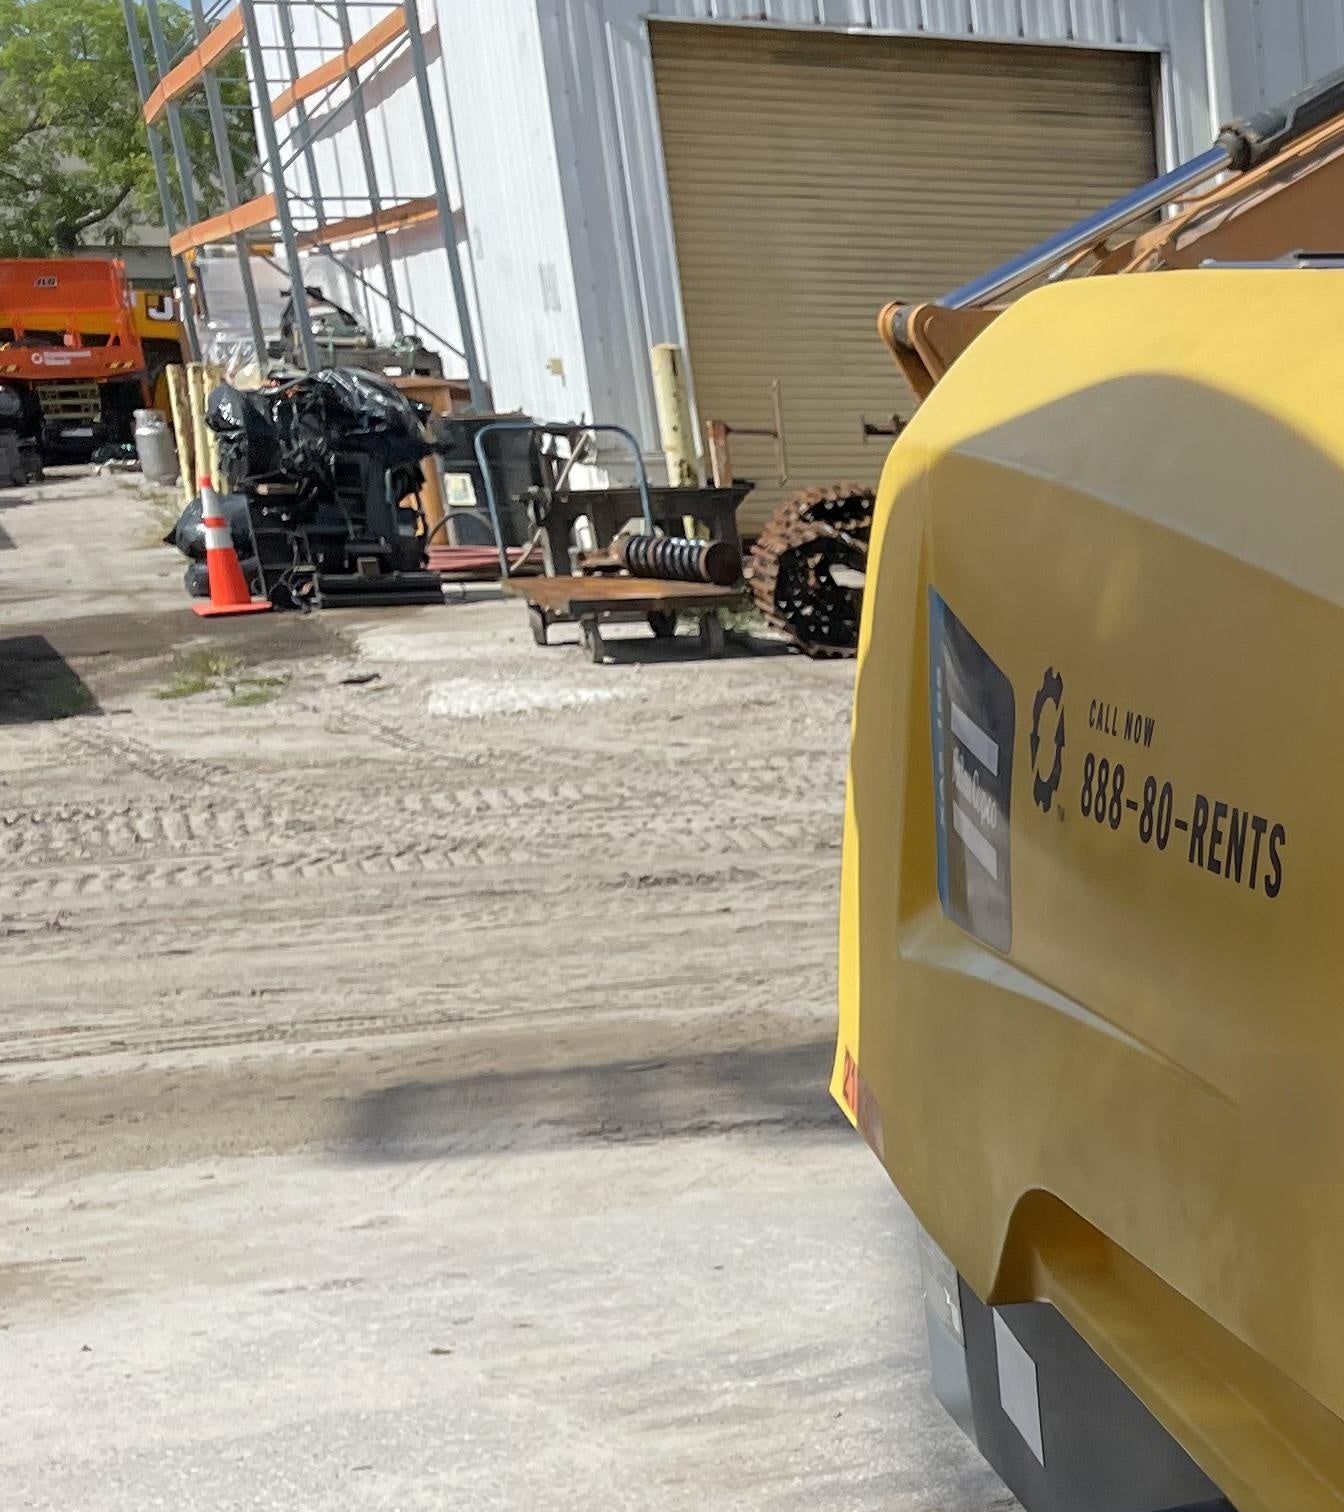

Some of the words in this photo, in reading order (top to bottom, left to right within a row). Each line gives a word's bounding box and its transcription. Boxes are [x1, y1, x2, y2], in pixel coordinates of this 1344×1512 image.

[1088, 699, 1117, 736] CALL
[1124, 710, 1155, 748] NOW
[1080, 752, 1286, 898] 888-80-RENTS
